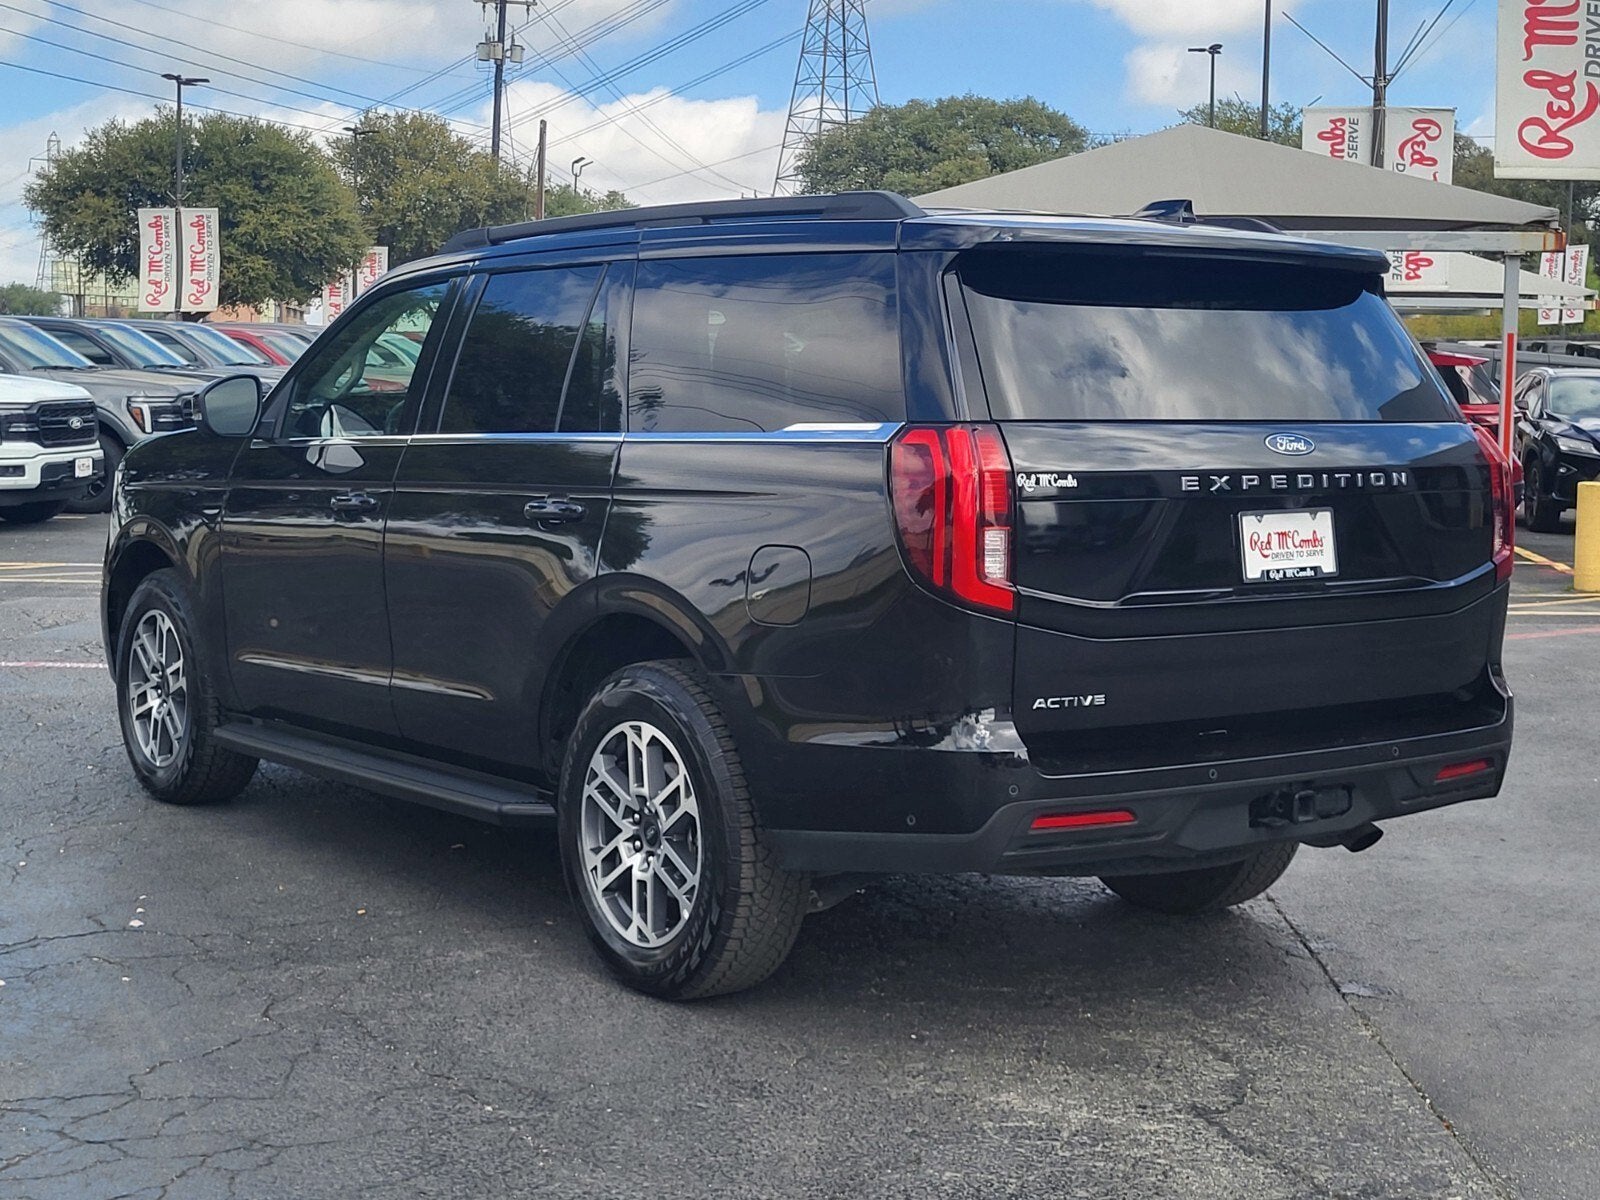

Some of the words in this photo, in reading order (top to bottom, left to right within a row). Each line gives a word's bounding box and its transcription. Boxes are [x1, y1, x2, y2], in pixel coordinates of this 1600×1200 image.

[1584, 0, 1600, 77] DRIVE
[1518, 69, 1599, 159] Red
[1348, 117, 1359, 159] SERVE
[1398, 118, 1442, 167] Red
[148, 215, 163, 277] McCombs
[164, 240, 170, 251] TO
[190, 214, 206, 276] McCombs
[207, 240, 213, 251] TO
[207, 254, 215, 281] DRIVEN
[145, 279, 168, 306] Red
[188, 279, 211, 305] Red
[1016, 473, 1036, 492] Red
[1036, 473, 1078, 488] McCombs
[1180, 472, 1408, 492] EXPEDITION
[1249, 531, 1273, 558] Red
[1273, 529, 1324, 550] McCombs
[1271, 551, 1295, 560] DRIVEN
[1296, 550, 1305, 558] TO
[1305, 549, 1324, 558] SERVE
[1032, 694, 1106, 710] ACTIVE
